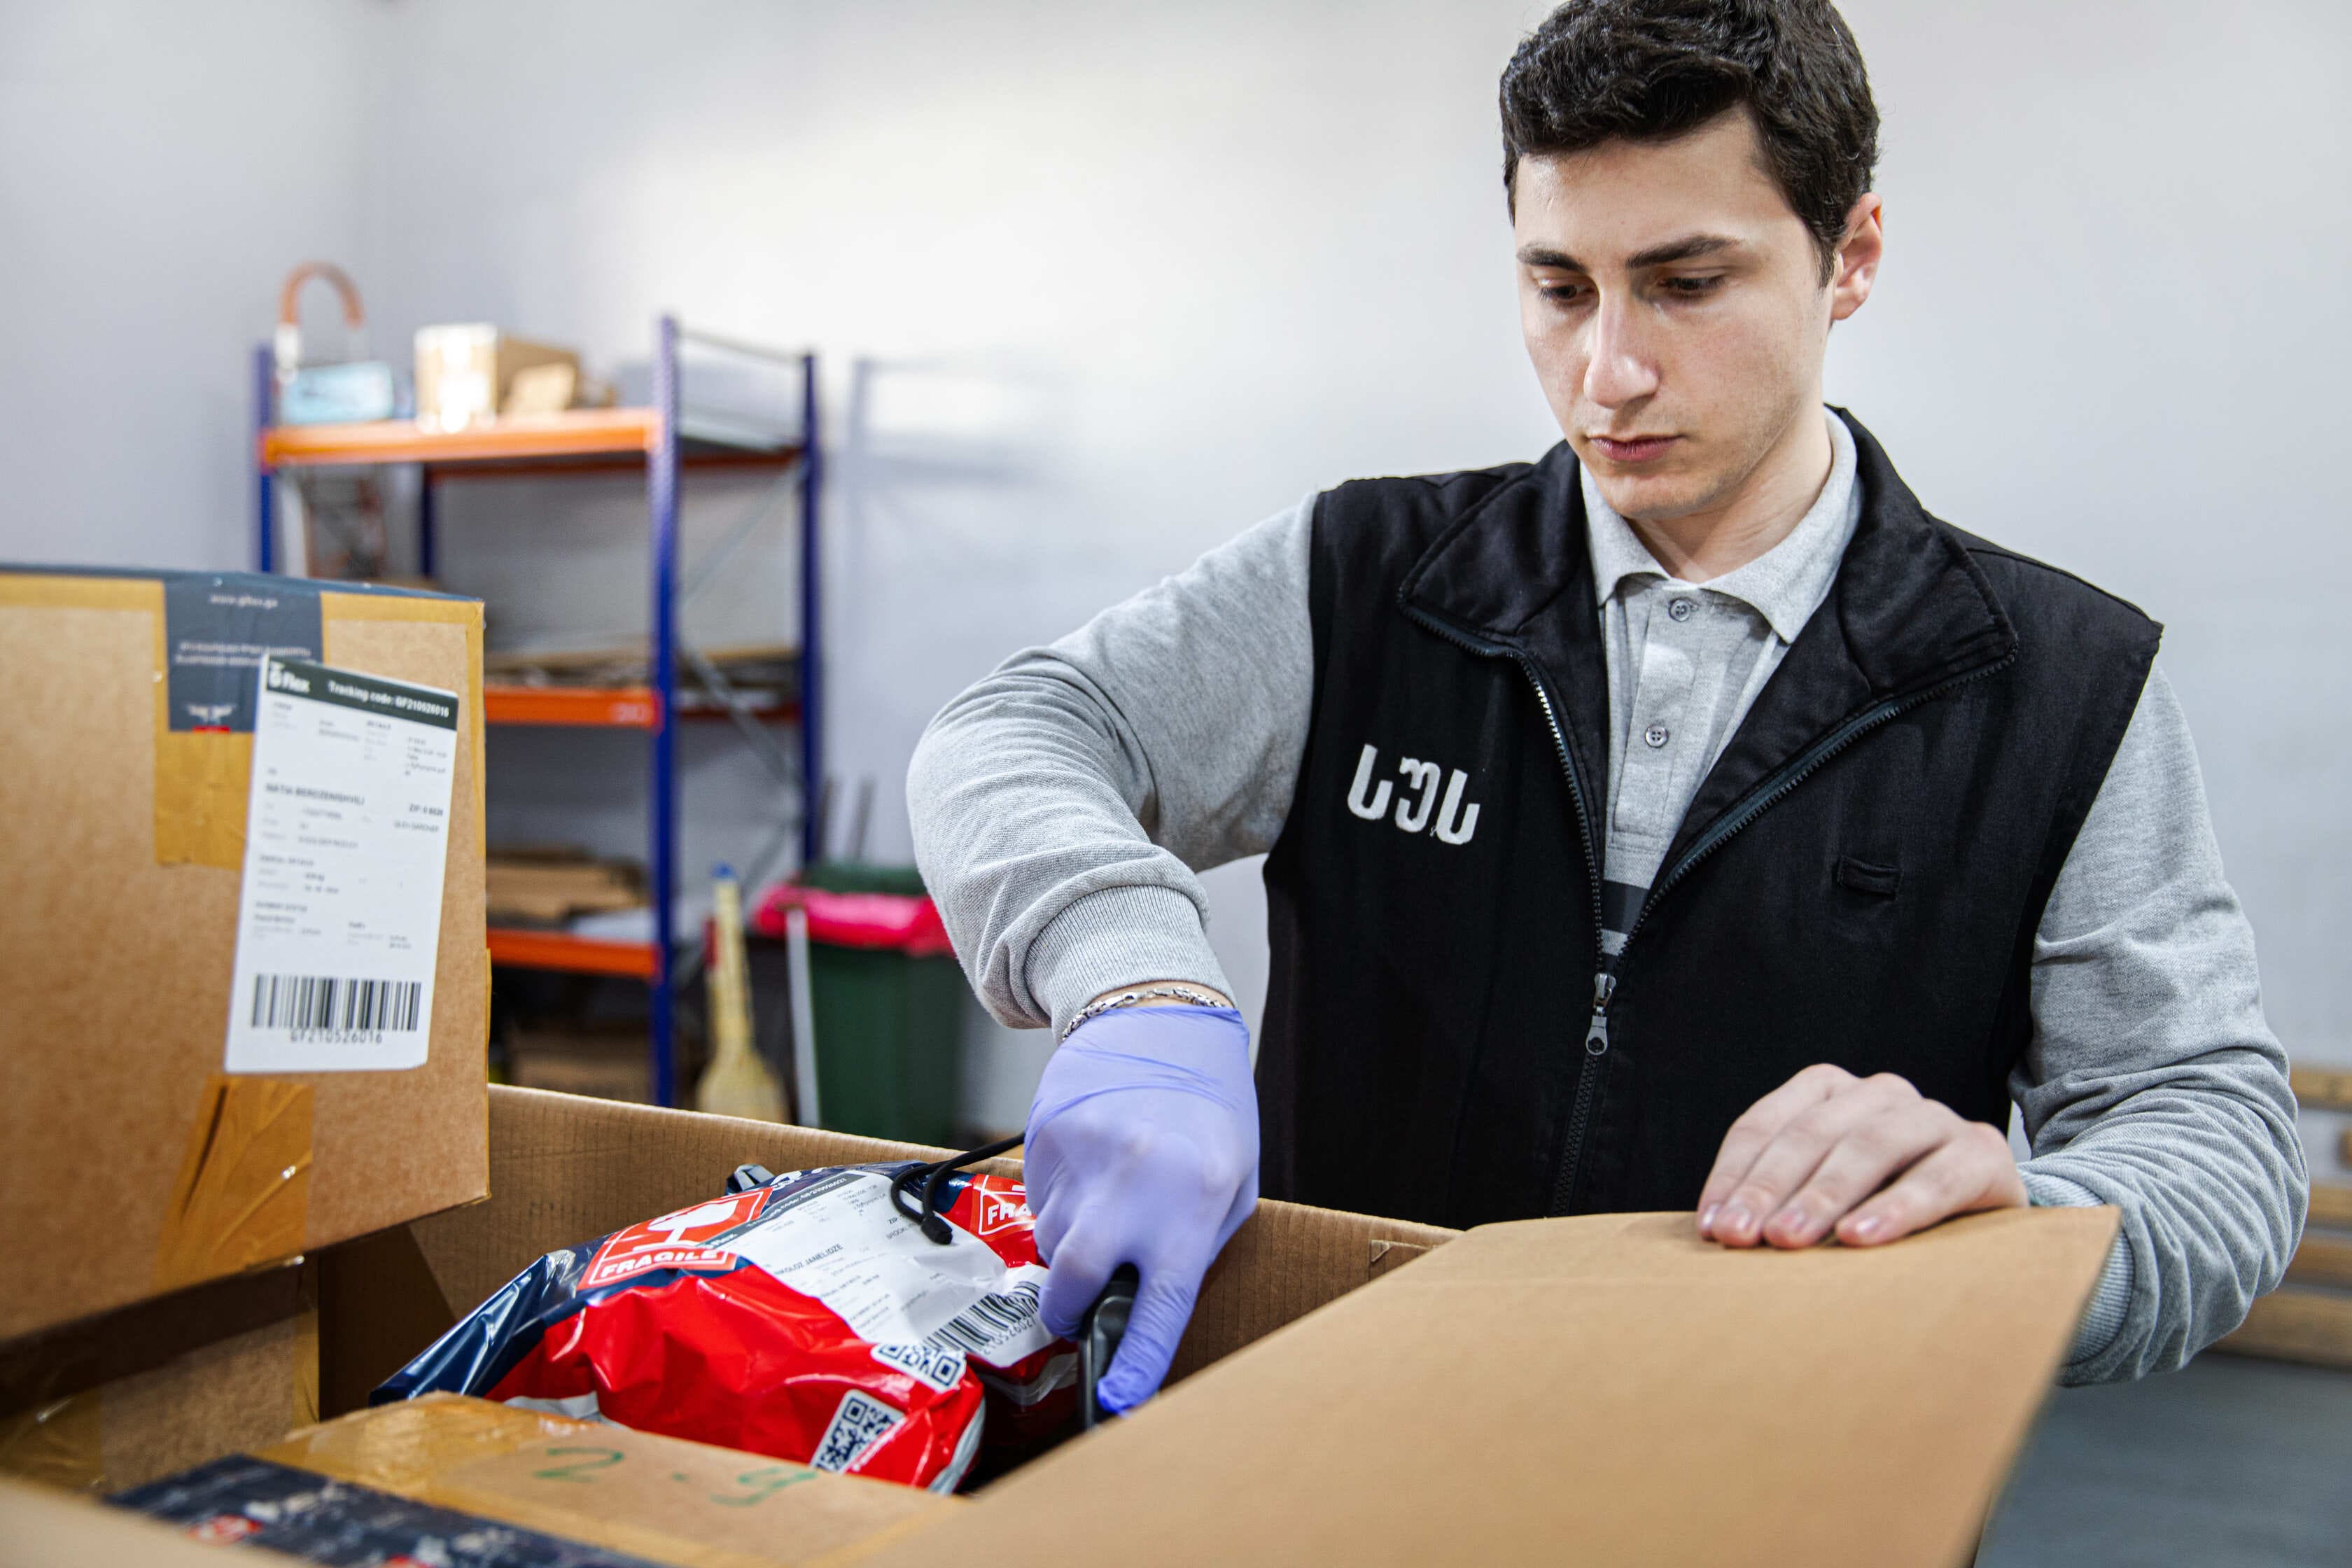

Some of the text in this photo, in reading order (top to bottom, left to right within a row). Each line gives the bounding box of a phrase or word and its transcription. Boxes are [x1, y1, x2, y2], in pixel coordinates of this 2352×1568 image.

[328, 680, 369, 702] Tracking
[988, 1202, 1032, 1226] FRA
[600, 1249, 720, 1278] FRAGILE
